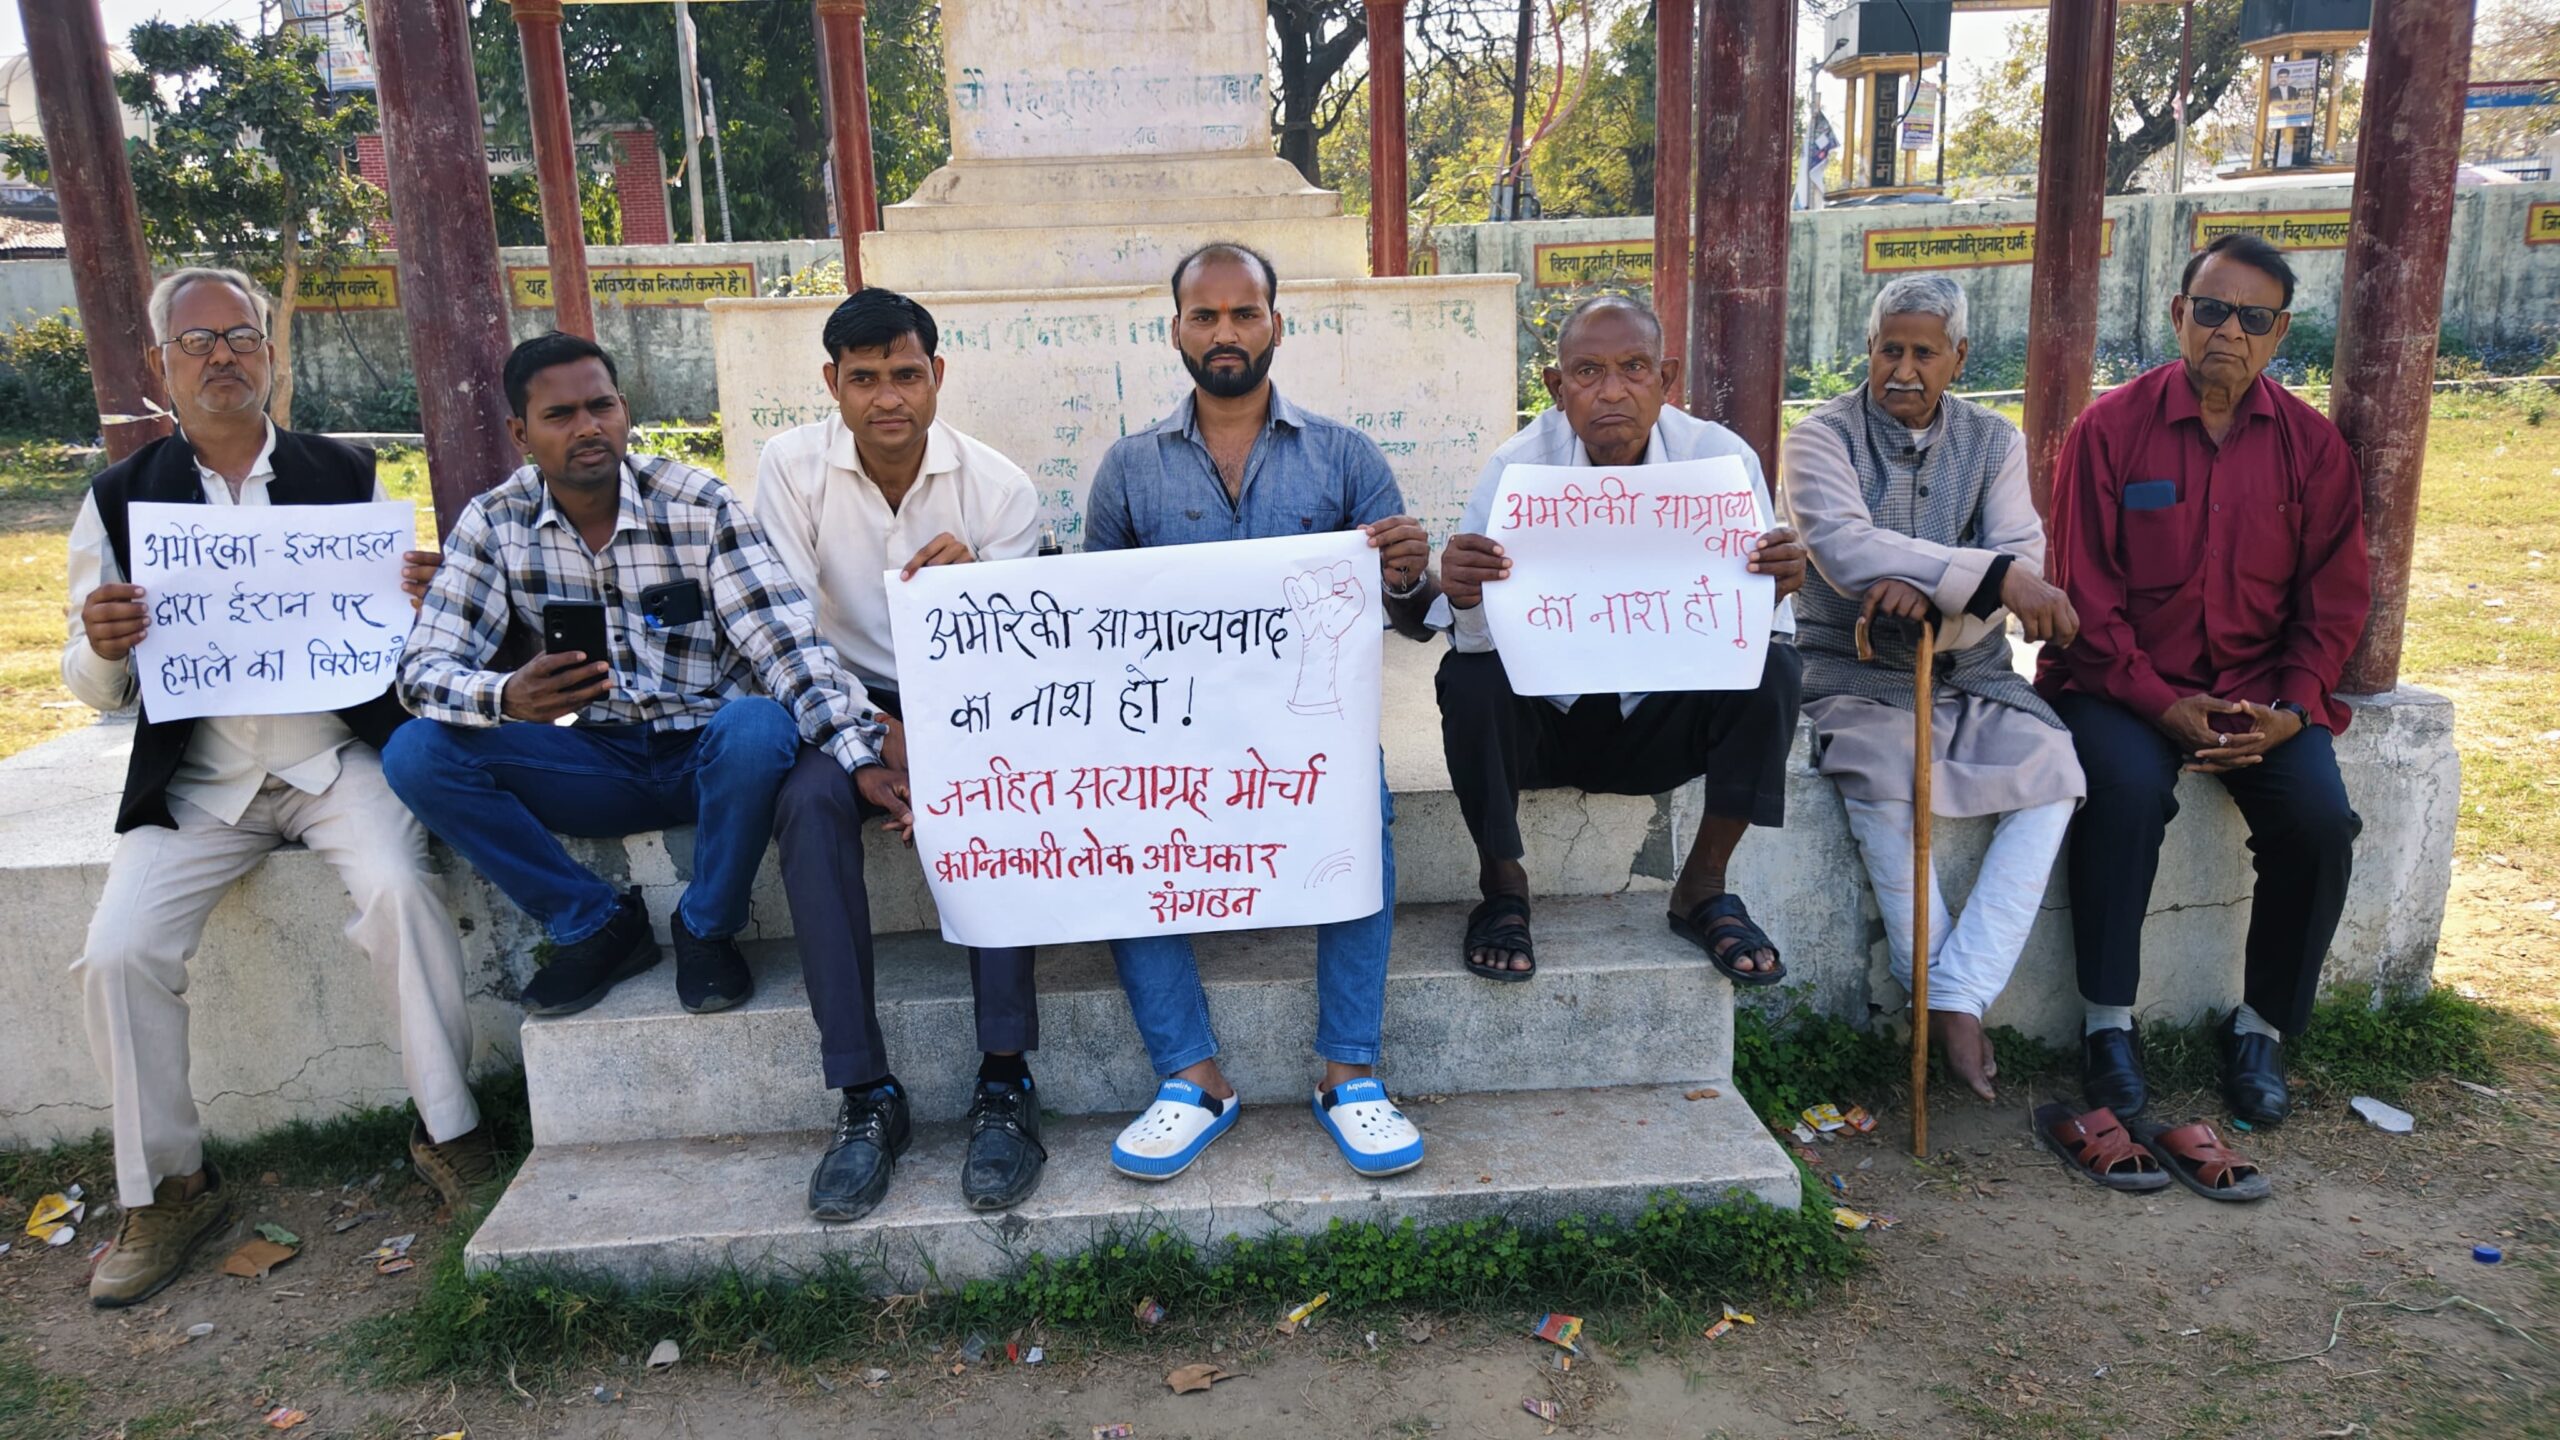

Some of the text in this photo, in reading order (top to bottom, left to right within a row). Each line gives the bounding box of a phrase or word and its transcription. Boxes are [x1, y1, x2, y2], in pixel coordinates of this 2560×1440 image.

[348, 274, 379, 297] करते
[525, 279, 547, 299] यह
[637, 279, 654, 294] का
[695, 273, 728, 294] करते
[1501, 476, 1645, 530] अमरीकी
[144, 521, 262, 570] अमेरिका
[283, 529, 404, 566] इजराइल
[155, 581, 391, 628] द्वारा ईरान पर
[926, 590, 1294, 665] अमेरिकी साम्राज्यवाद
[1527, 593, 1577, 633] का
[1590, 590, 1670, 634] नाश
[161, 641, 238, 696] हमले
[246, 649, 285, 682] का
[307, 639, 383, 681] विरोध
[950, 691, 992, 734] का
[1011, 678, 1097, 728] नाश
[926, 747, 1327, 822] जनहित सत्याग्रह मोर्चा
[935, 828, 1287, 883] क्रान्तिकारी लोक अधिकार
[1148, 881, 1262, 923] संगठन
